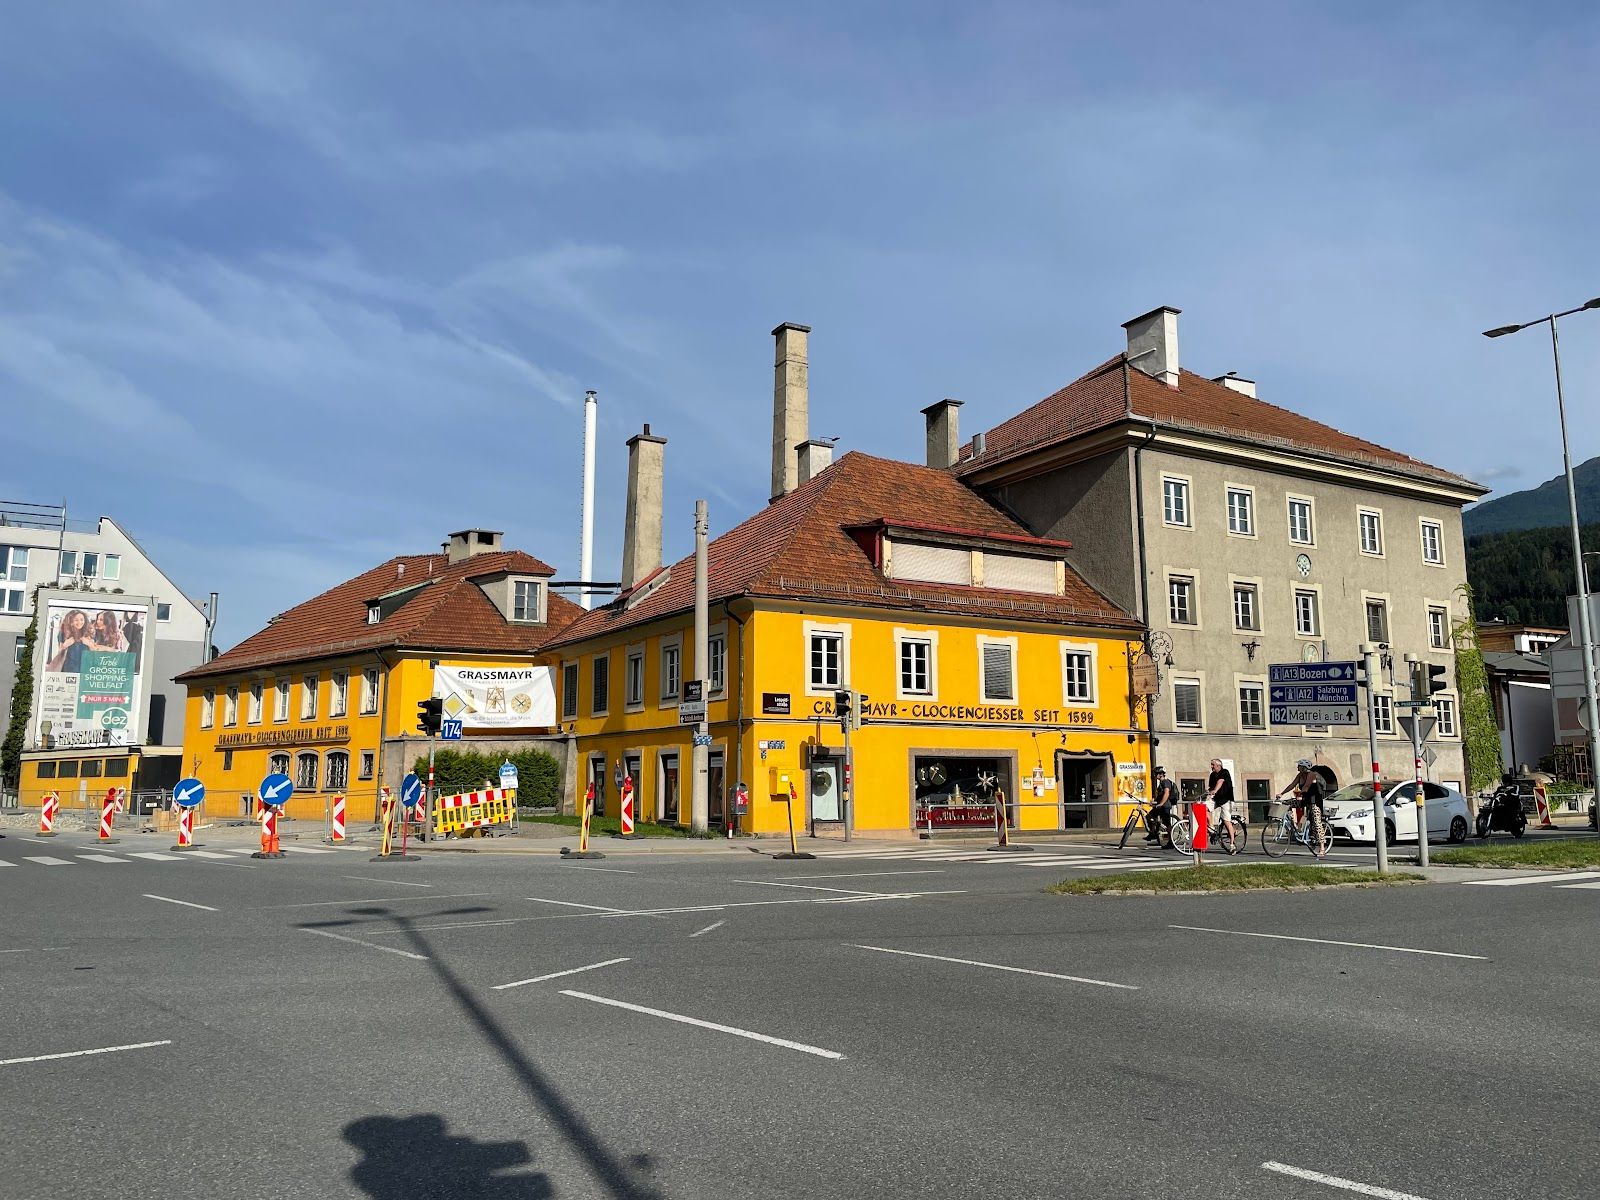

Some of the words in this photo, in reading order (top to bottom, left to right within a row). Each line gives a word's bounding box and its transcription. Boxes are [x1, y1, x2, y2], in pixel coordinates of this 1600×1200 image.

[458, 670, 532, 680] GRASSMAYR
[1283, 667, 1298, 679] A13
[1300, 668, 1327, 679] Bozen
[89, 681, 124, 689] VIELFALT
[1317, 686, 1347, 694] Salzburg
[1298, 688, 1312, 699] A12
[1317, 694, 1349, 702] München
[101, 710, 127, 725] dez
[912, 704, 1024, 721] GLOCKENGIESSER
[1034, 709, 1060, 723] SEIT
[1067, 711, 1094, 723] 1599
[1270, 707, 1287, 722] 182
[1289, 710, 1321, 721] Matrei
[1333, 711, 1345, 721] Br.
[443, 722, 461, 738] 174
